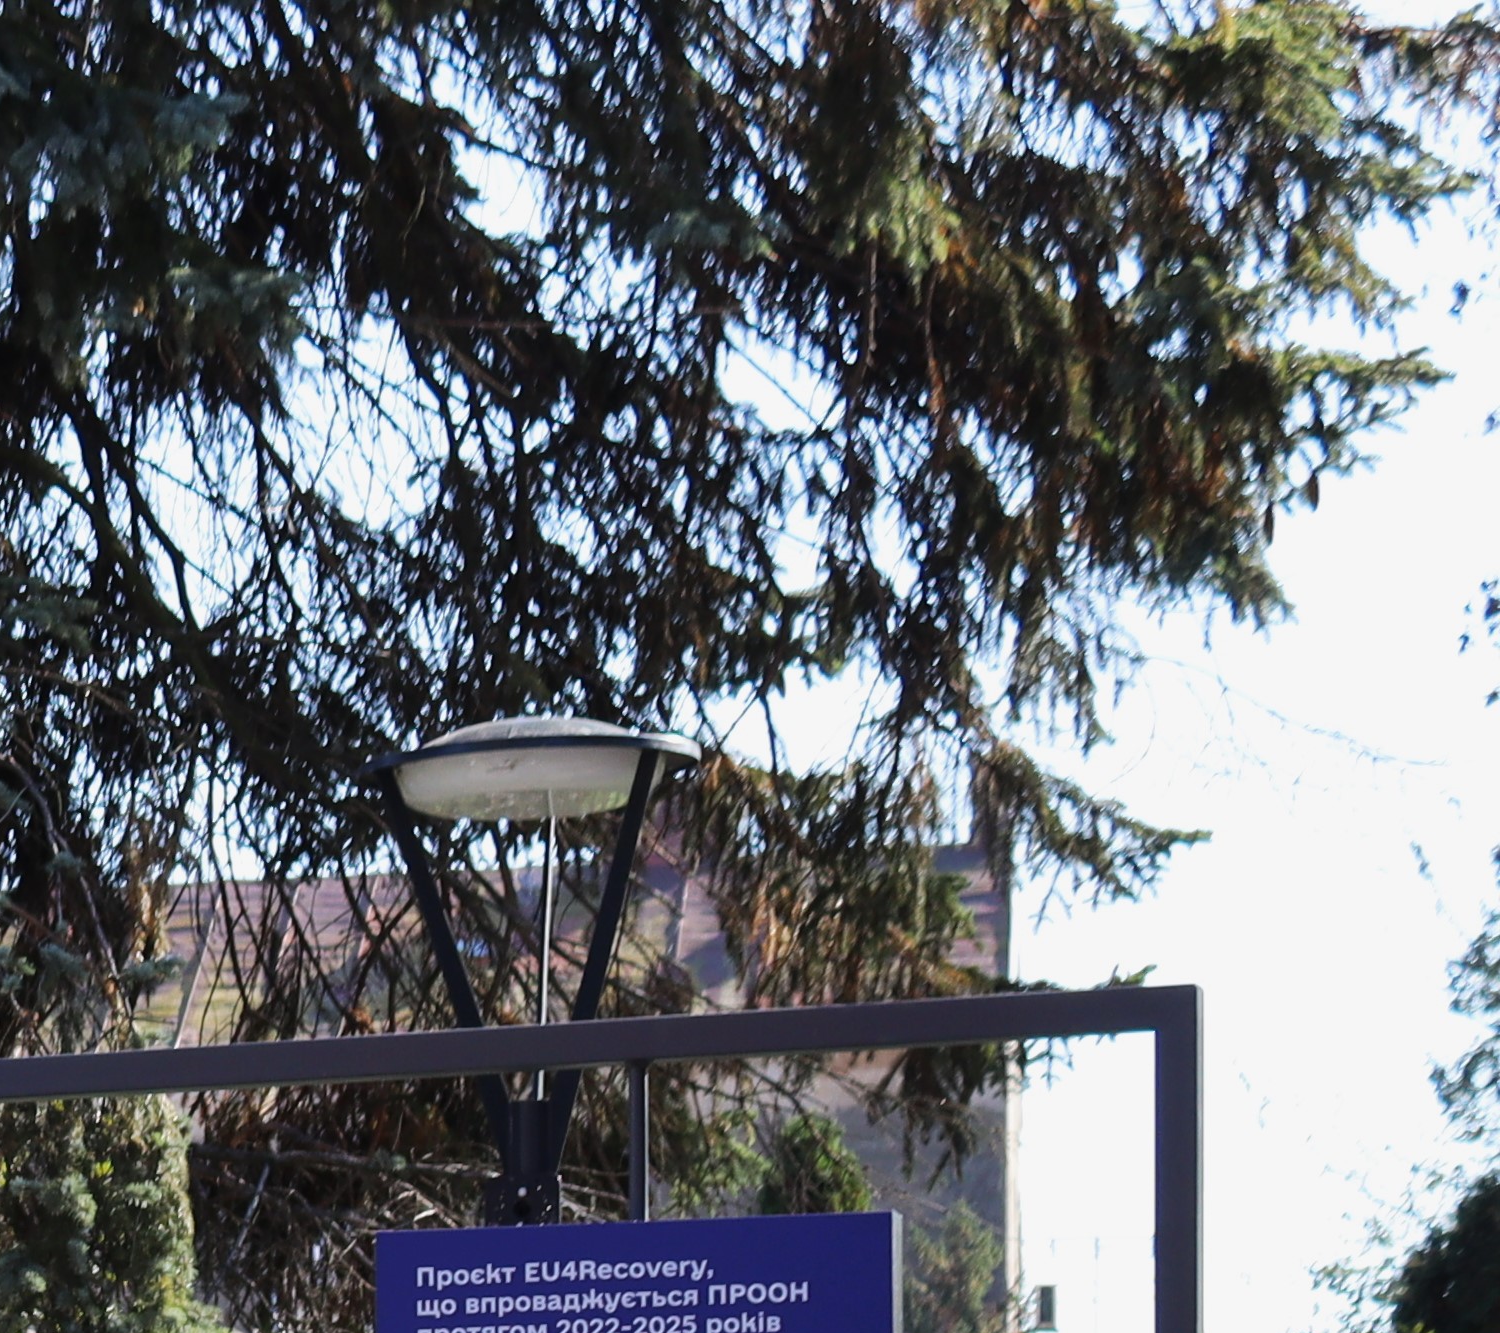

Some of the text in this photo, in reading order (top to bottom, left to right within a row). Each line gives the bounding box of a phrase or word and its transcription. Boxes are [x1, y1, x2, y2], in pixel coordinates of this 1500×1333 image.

[416, 1259, 714, 1292] Проєкт EU4Recovery,
[416, 1281, 809, 1319] що впроваджується ПРООН
